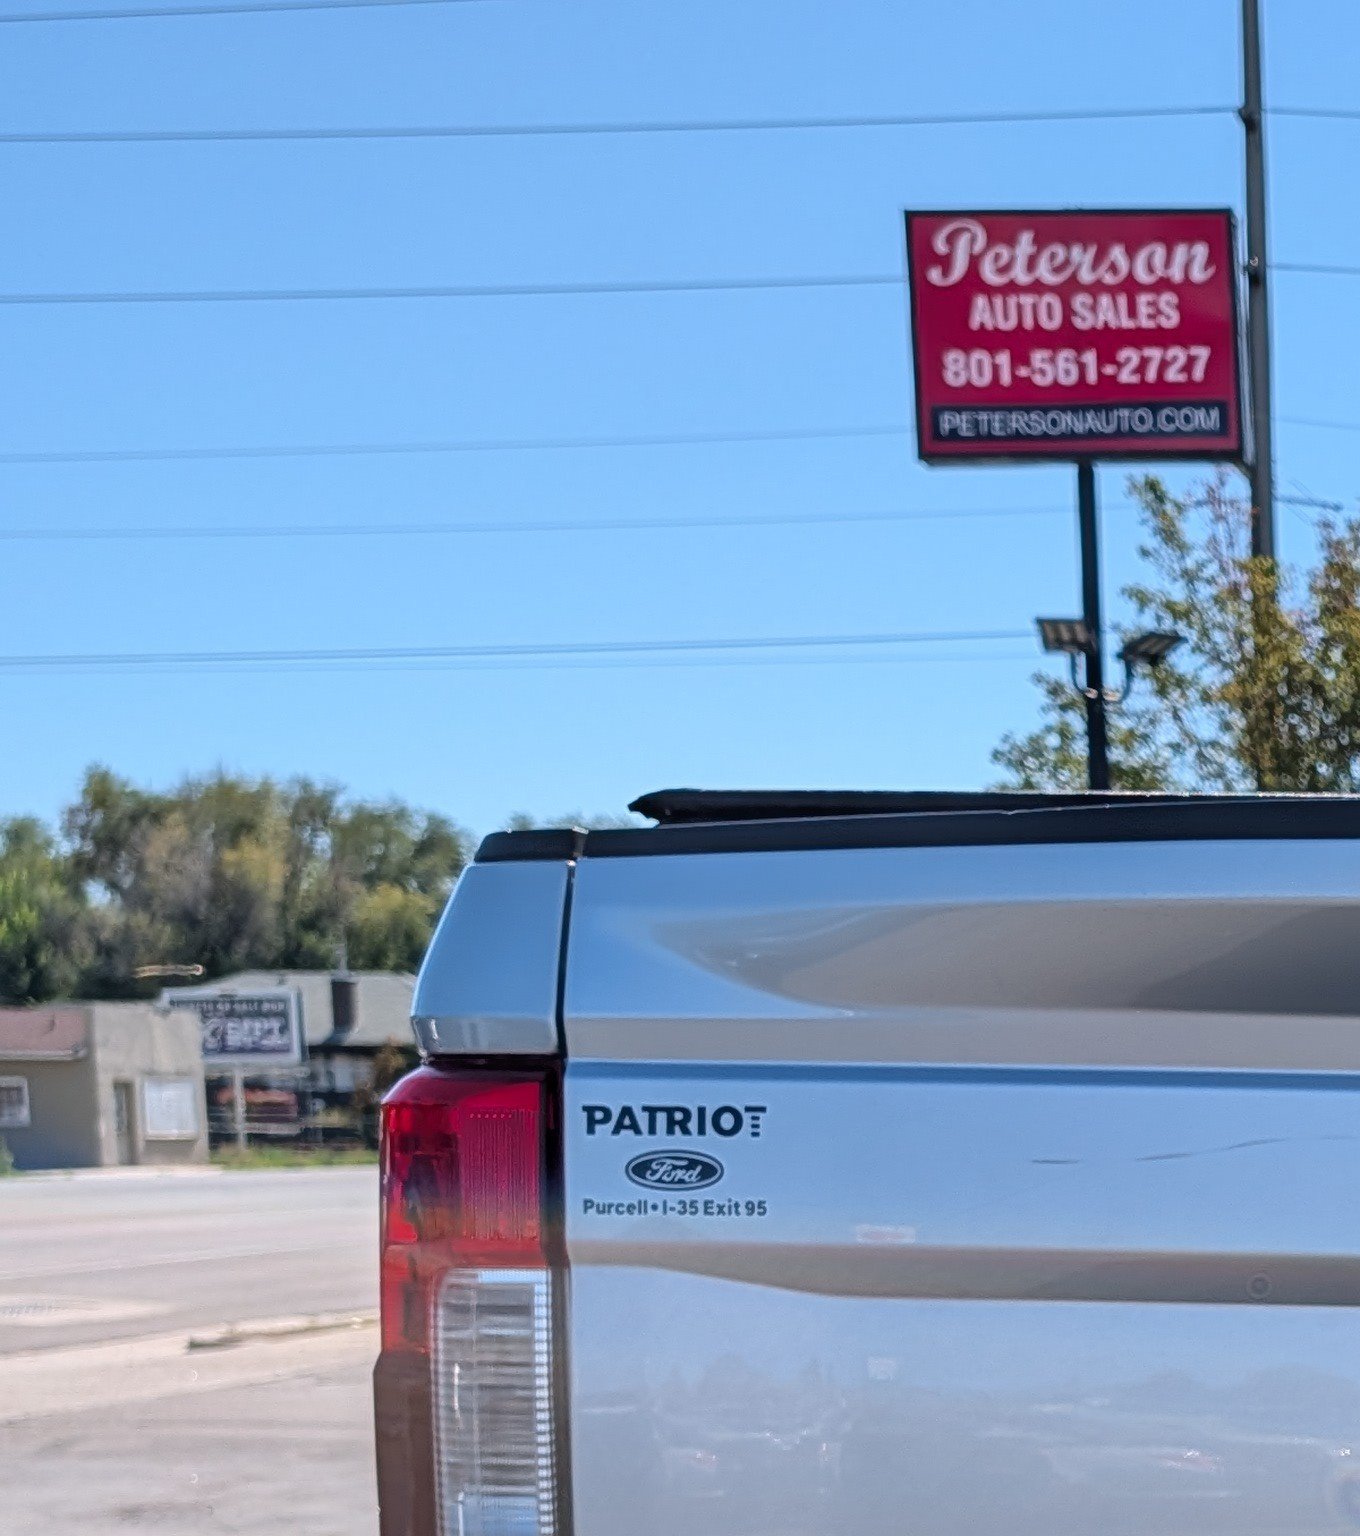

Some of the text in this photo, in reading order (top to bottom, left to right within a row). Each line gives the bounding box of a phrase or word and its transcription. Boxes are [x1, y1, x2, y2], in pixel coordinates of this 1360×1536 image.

[926, 218, 1216, 287] Peterson
[968, 291, 1181, 331] AUTO SALES
[942, 346, 1212, 388] 801-561-2727
[939, 406, 1220, 437] PETERSONAUTO.COM
[582, 1105, 767, 1137] PATRIOT
[646, 1158, 702, 1183] Ford
[703, 1199, 741, 1216] Exit
[745, 1200, 767, 1216] 95
